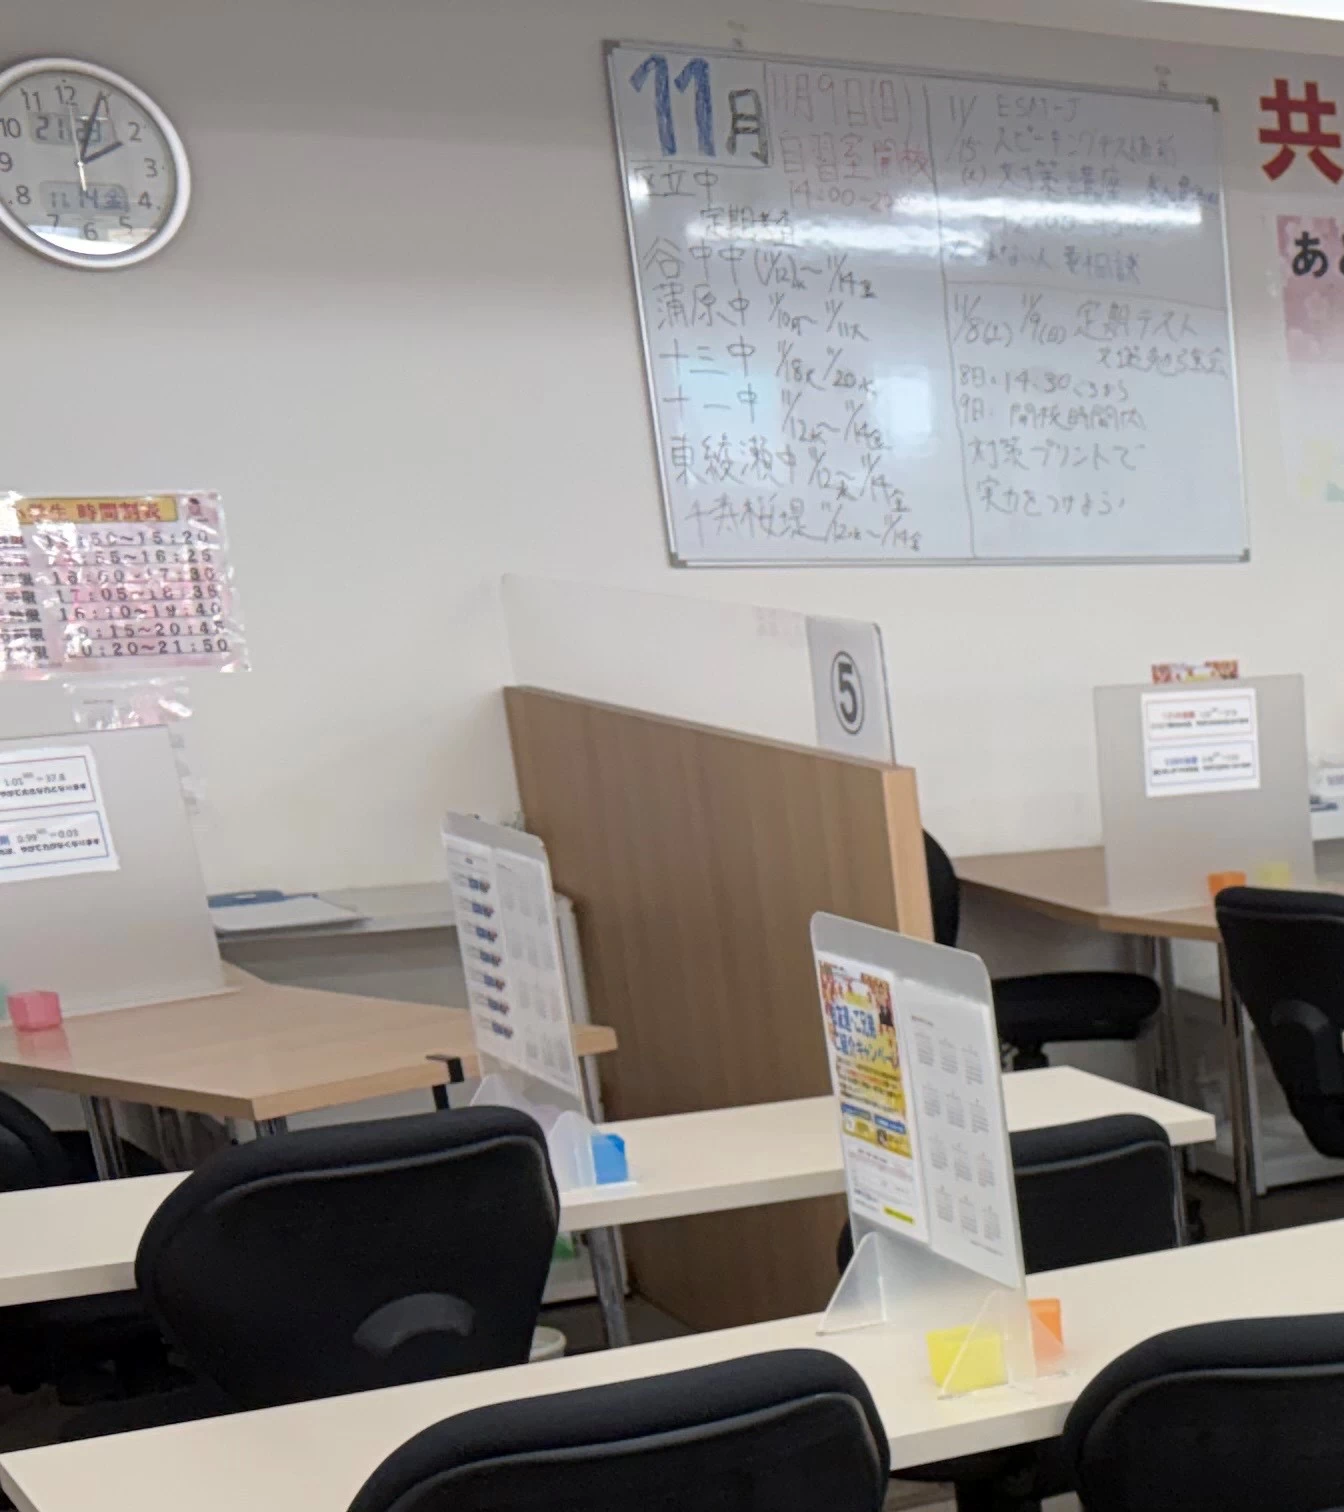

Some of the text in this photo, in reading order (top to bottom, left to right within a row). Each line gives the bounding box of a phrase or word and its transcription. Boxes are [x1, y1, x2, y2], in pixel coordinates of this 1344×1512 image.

[21, 87, 41, 113] 11
[629, 54, 769, 166] 11月
[128, 121, 142, 141] 2
[144, 158, 158, 178] 3
[15, 185, 31, 206] 8
[138, 191, 153, 210] 4
[47, 213, 60, 228] 7
[83, 221, 98, 241] 6
